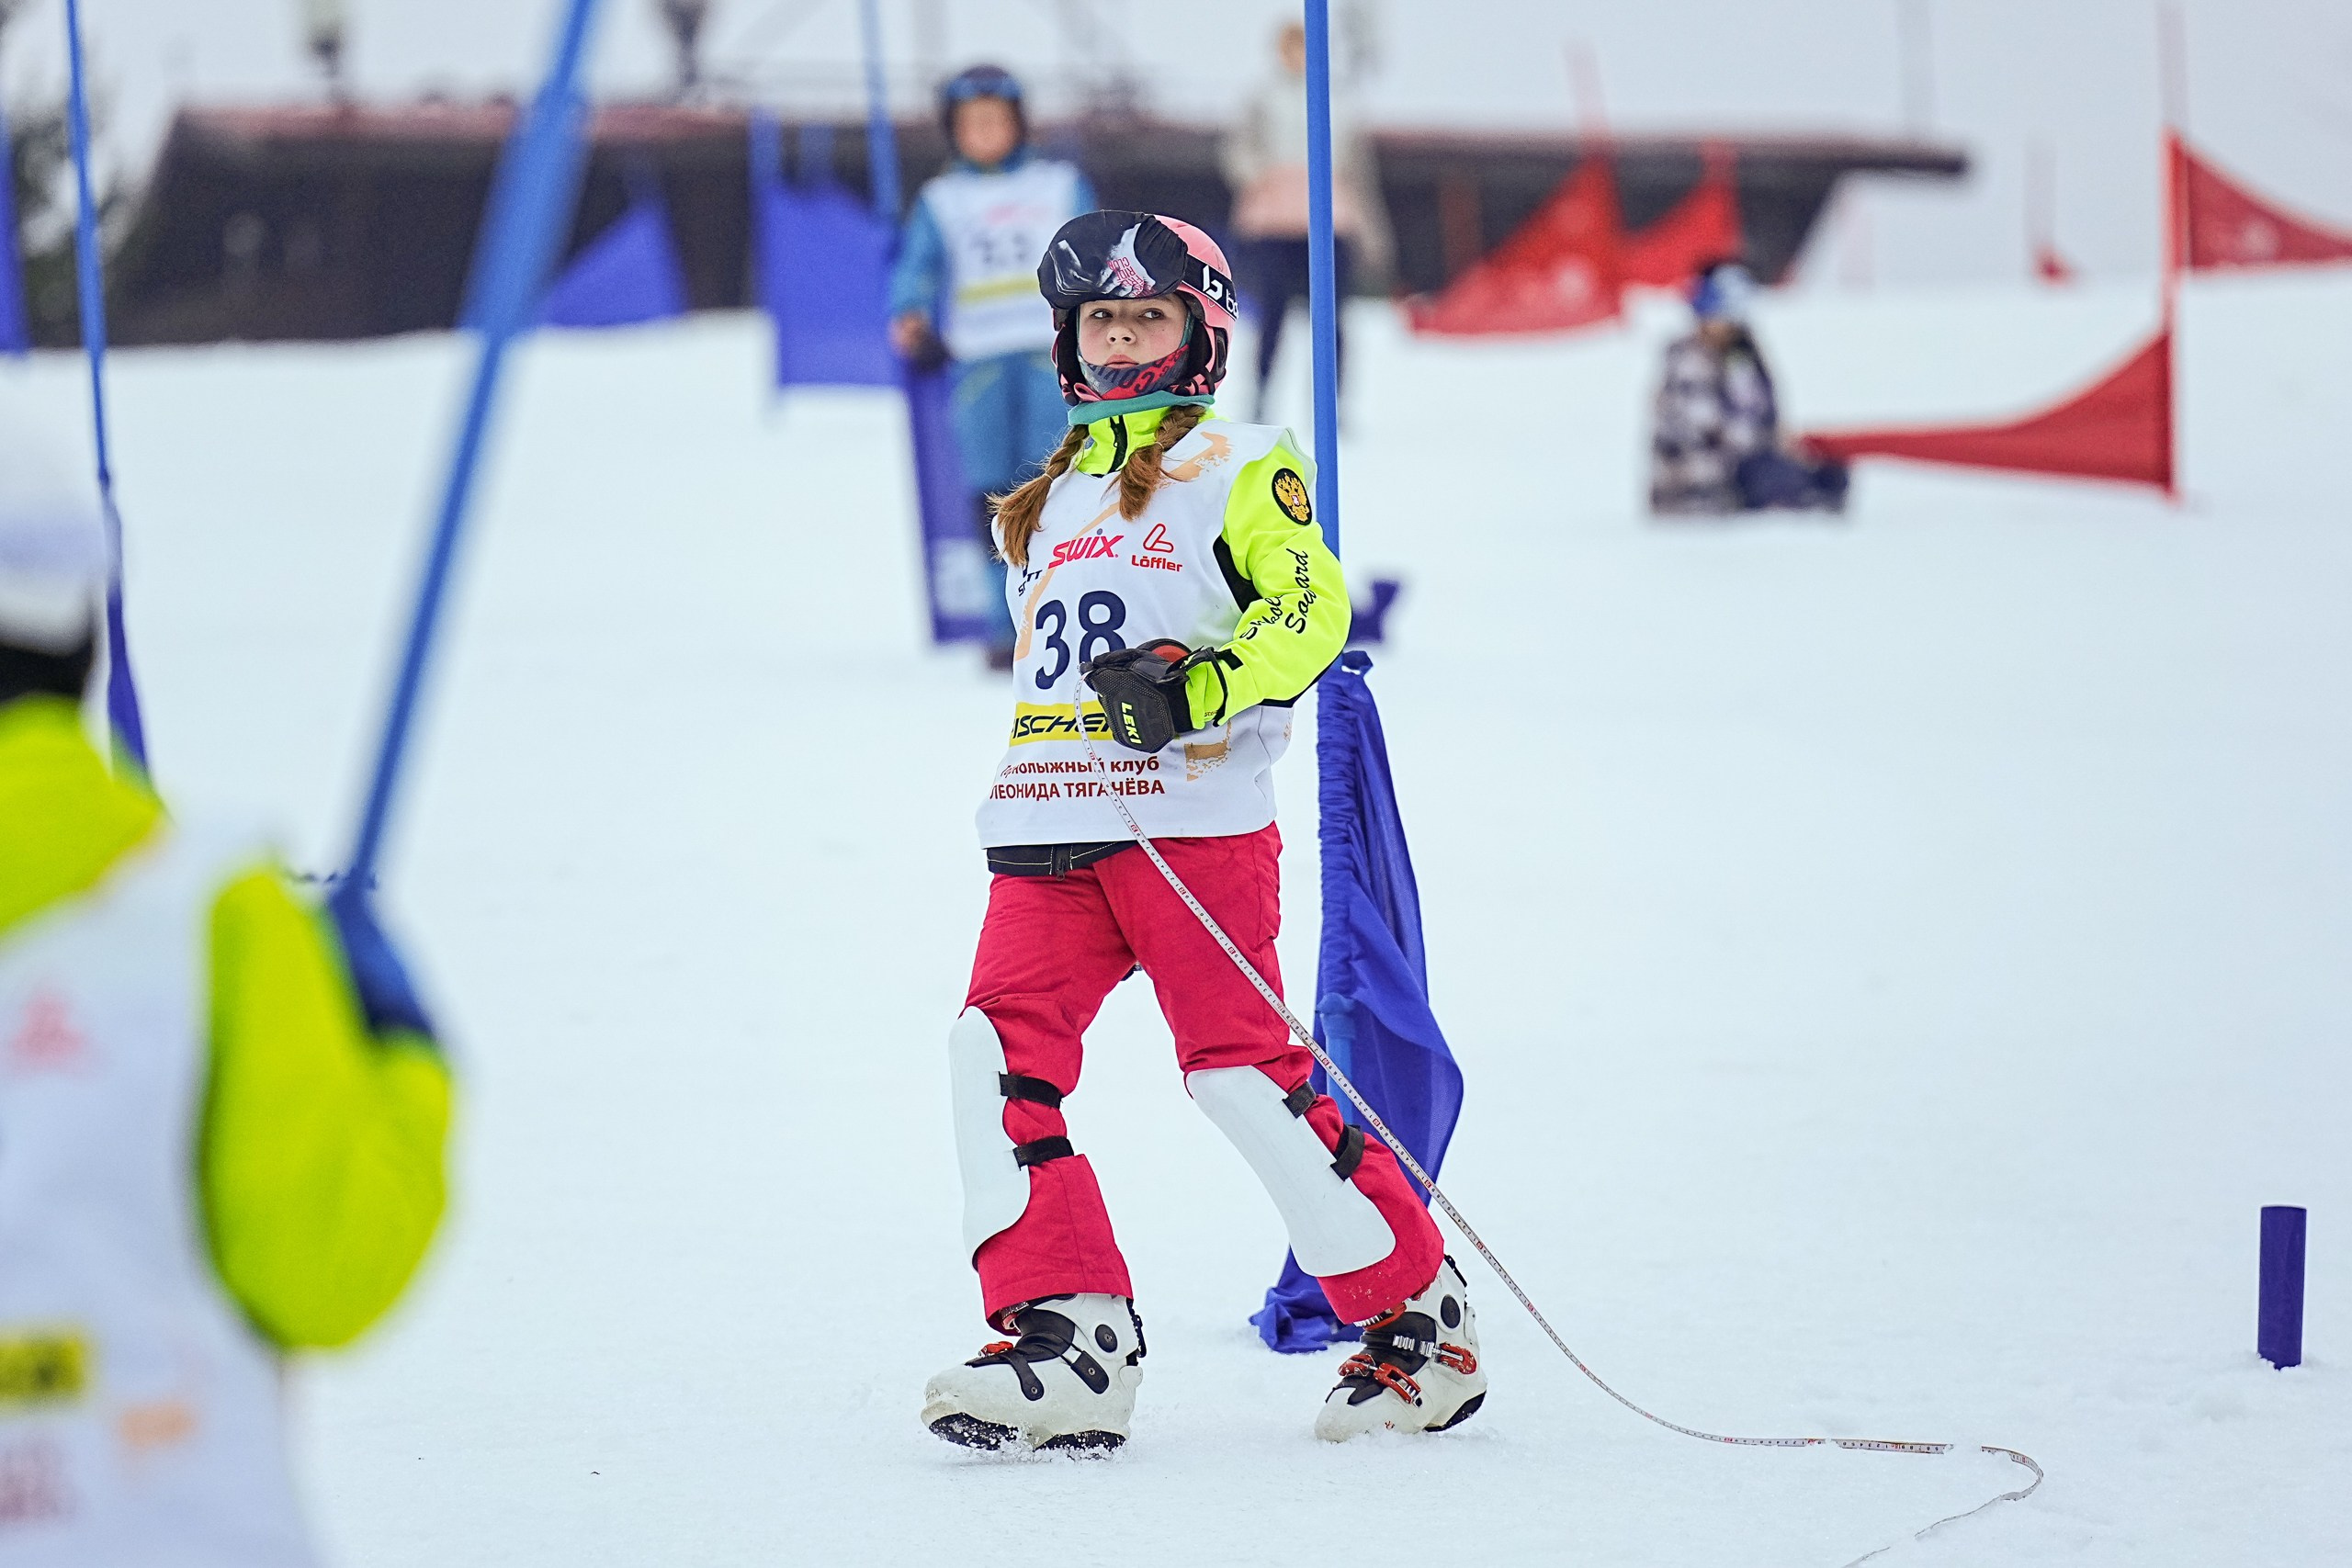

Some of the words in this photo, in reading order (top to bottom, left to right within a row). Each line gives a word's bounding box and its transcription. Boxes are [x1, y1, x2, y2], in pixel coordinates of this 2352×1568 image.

[1131, 554, 1183, 572] Löffler
[1035, 590, 1126, 690] 38
[1012, 712, 1110, 739] ISCHE
[1121, 701, 1143, 744] LEKI
[1110, 755, 1160, 775] клуб
[989, 782, 1061, 802] ЛЕОНИДА
[1063, 777, 1166, 798] ТЯГАЧЁВА
